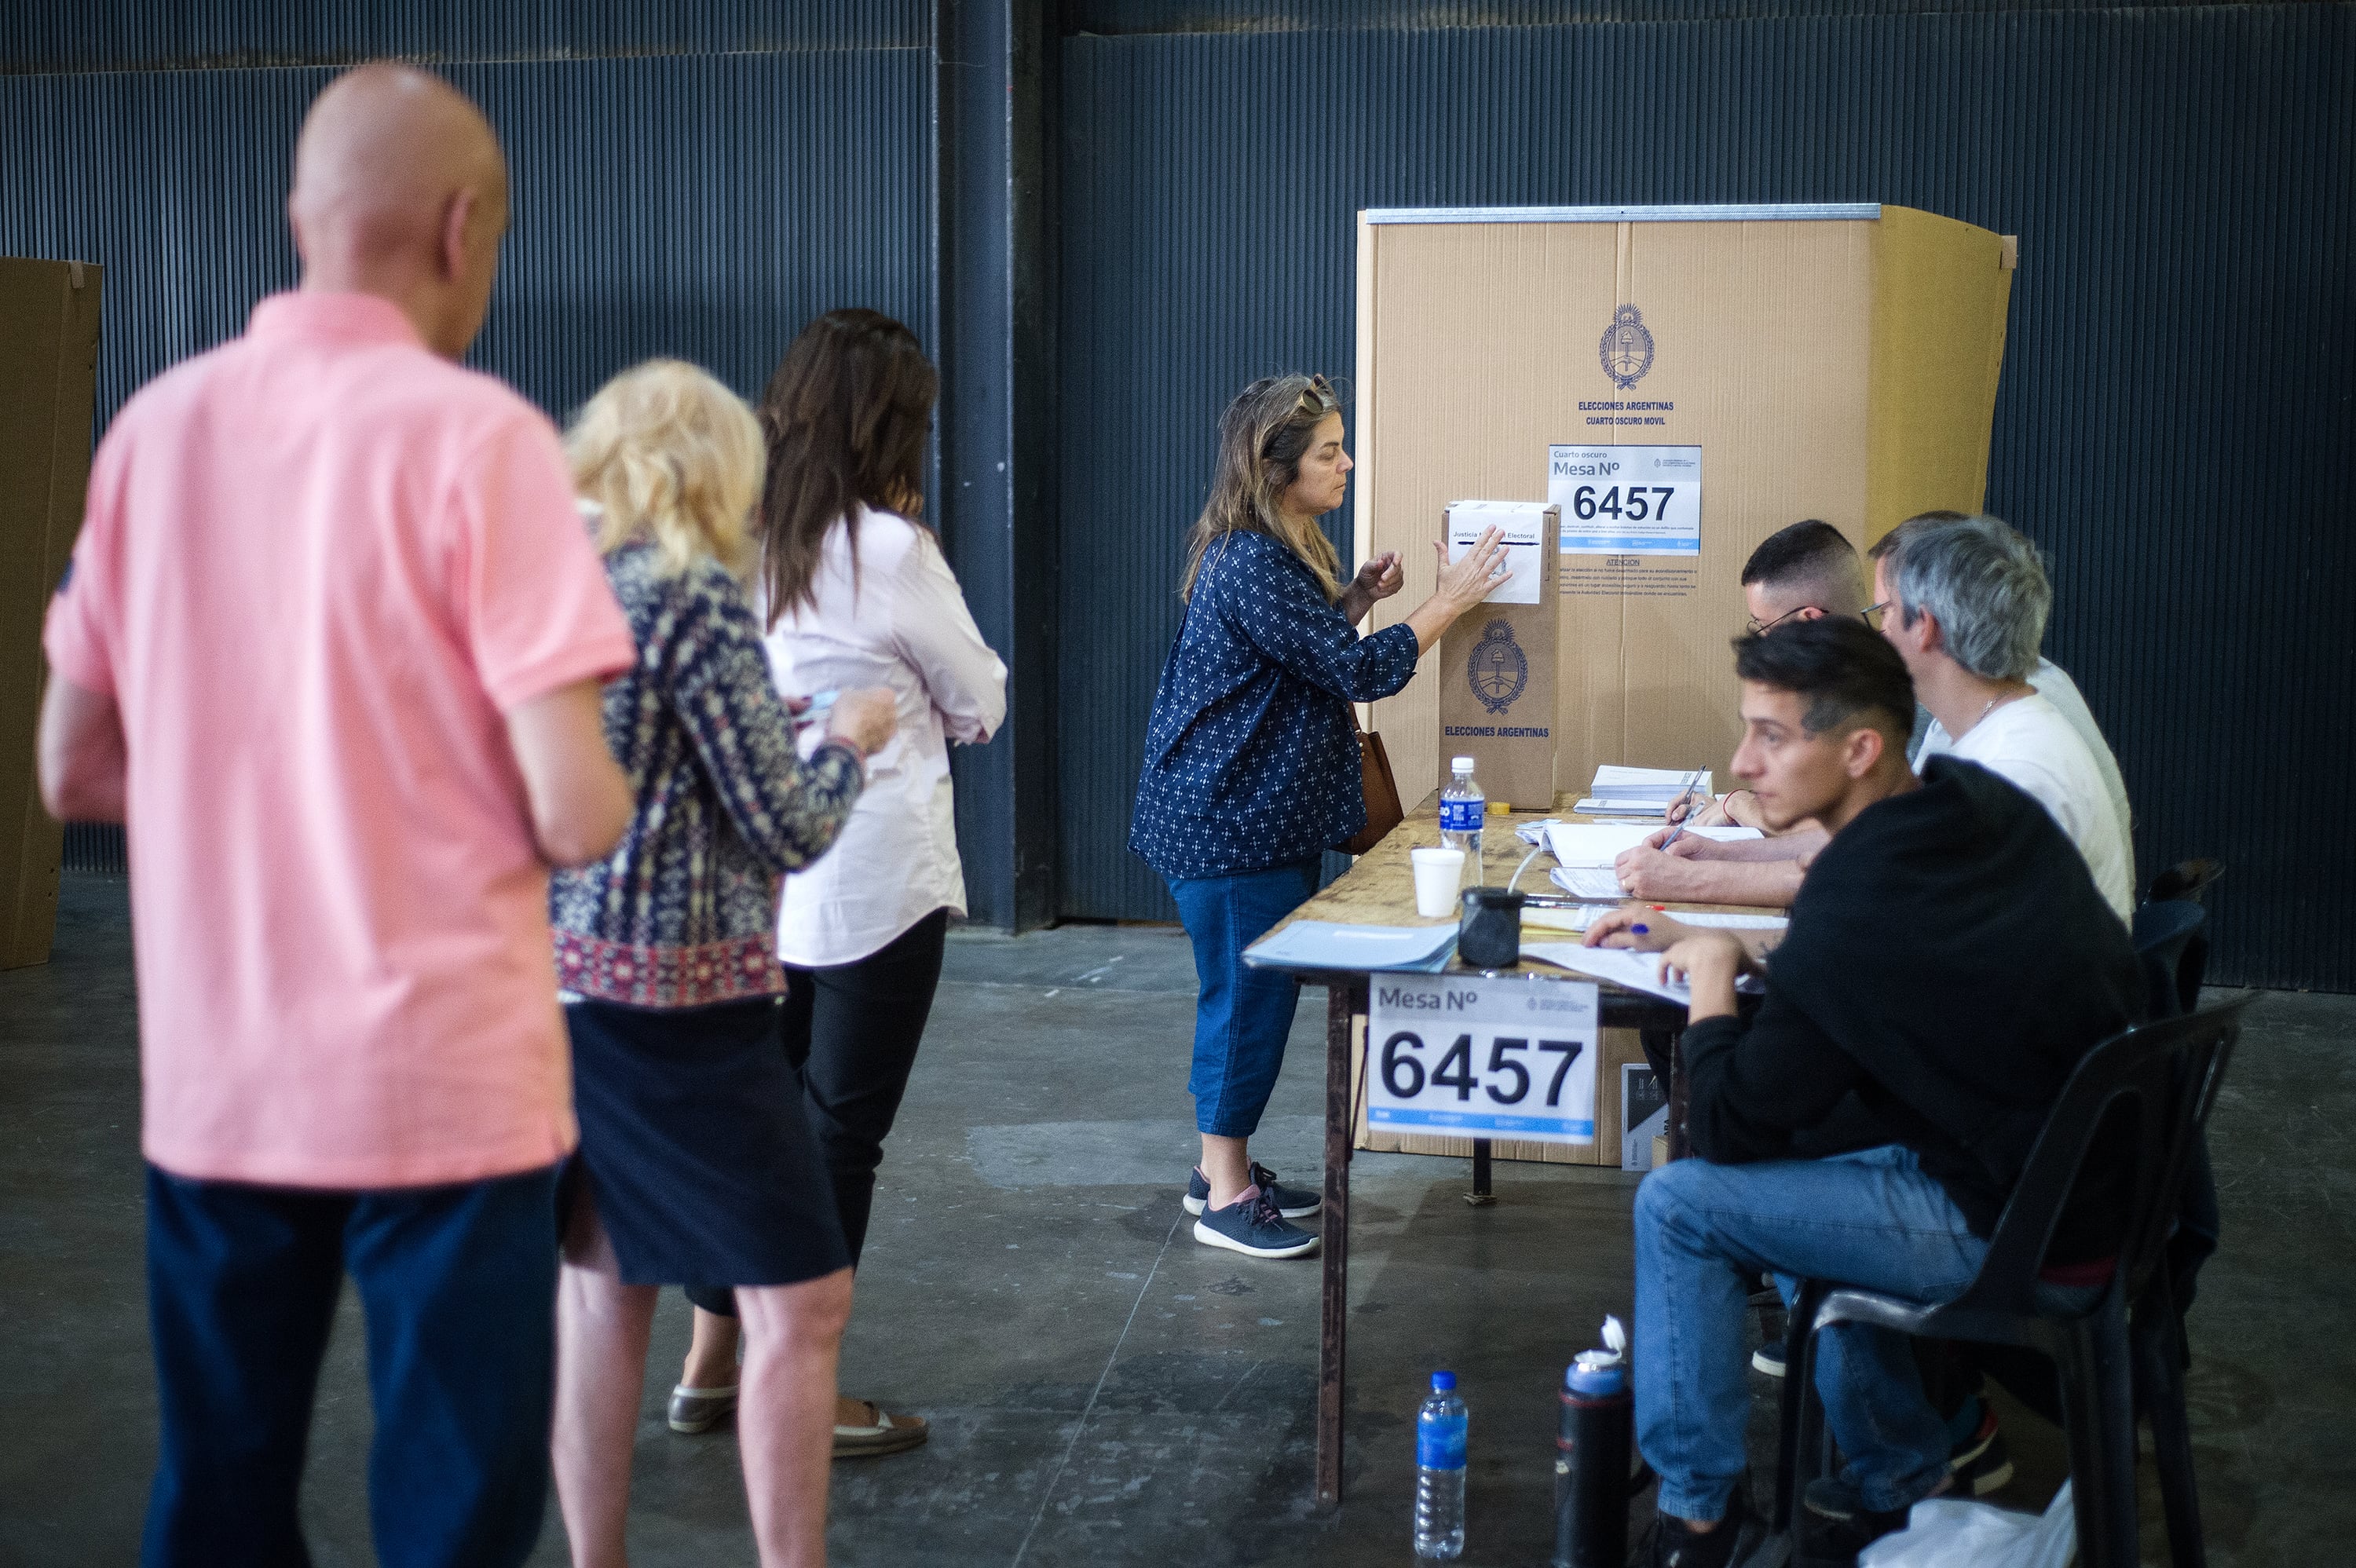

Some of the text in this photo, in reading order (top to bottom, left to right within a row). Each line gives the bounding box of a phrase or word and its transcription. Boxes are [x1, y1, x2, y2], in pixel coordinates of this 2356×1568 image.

[1579, 401, 1674, 411] ELECCIONES ARGENTINAS
[1586, 416, 1666, 425] CUARTO OSCURO MOVIL
[1553, 462, 1595, 476] Mesa
[1573, 485, 1675, 521] 6457
[1445, 726, 1549, 738] ELECCIONES ARGENTINAS
[1379, 988, 1440, 1010] Mesa
[1381, 1030, 1583, 1108] 6457
